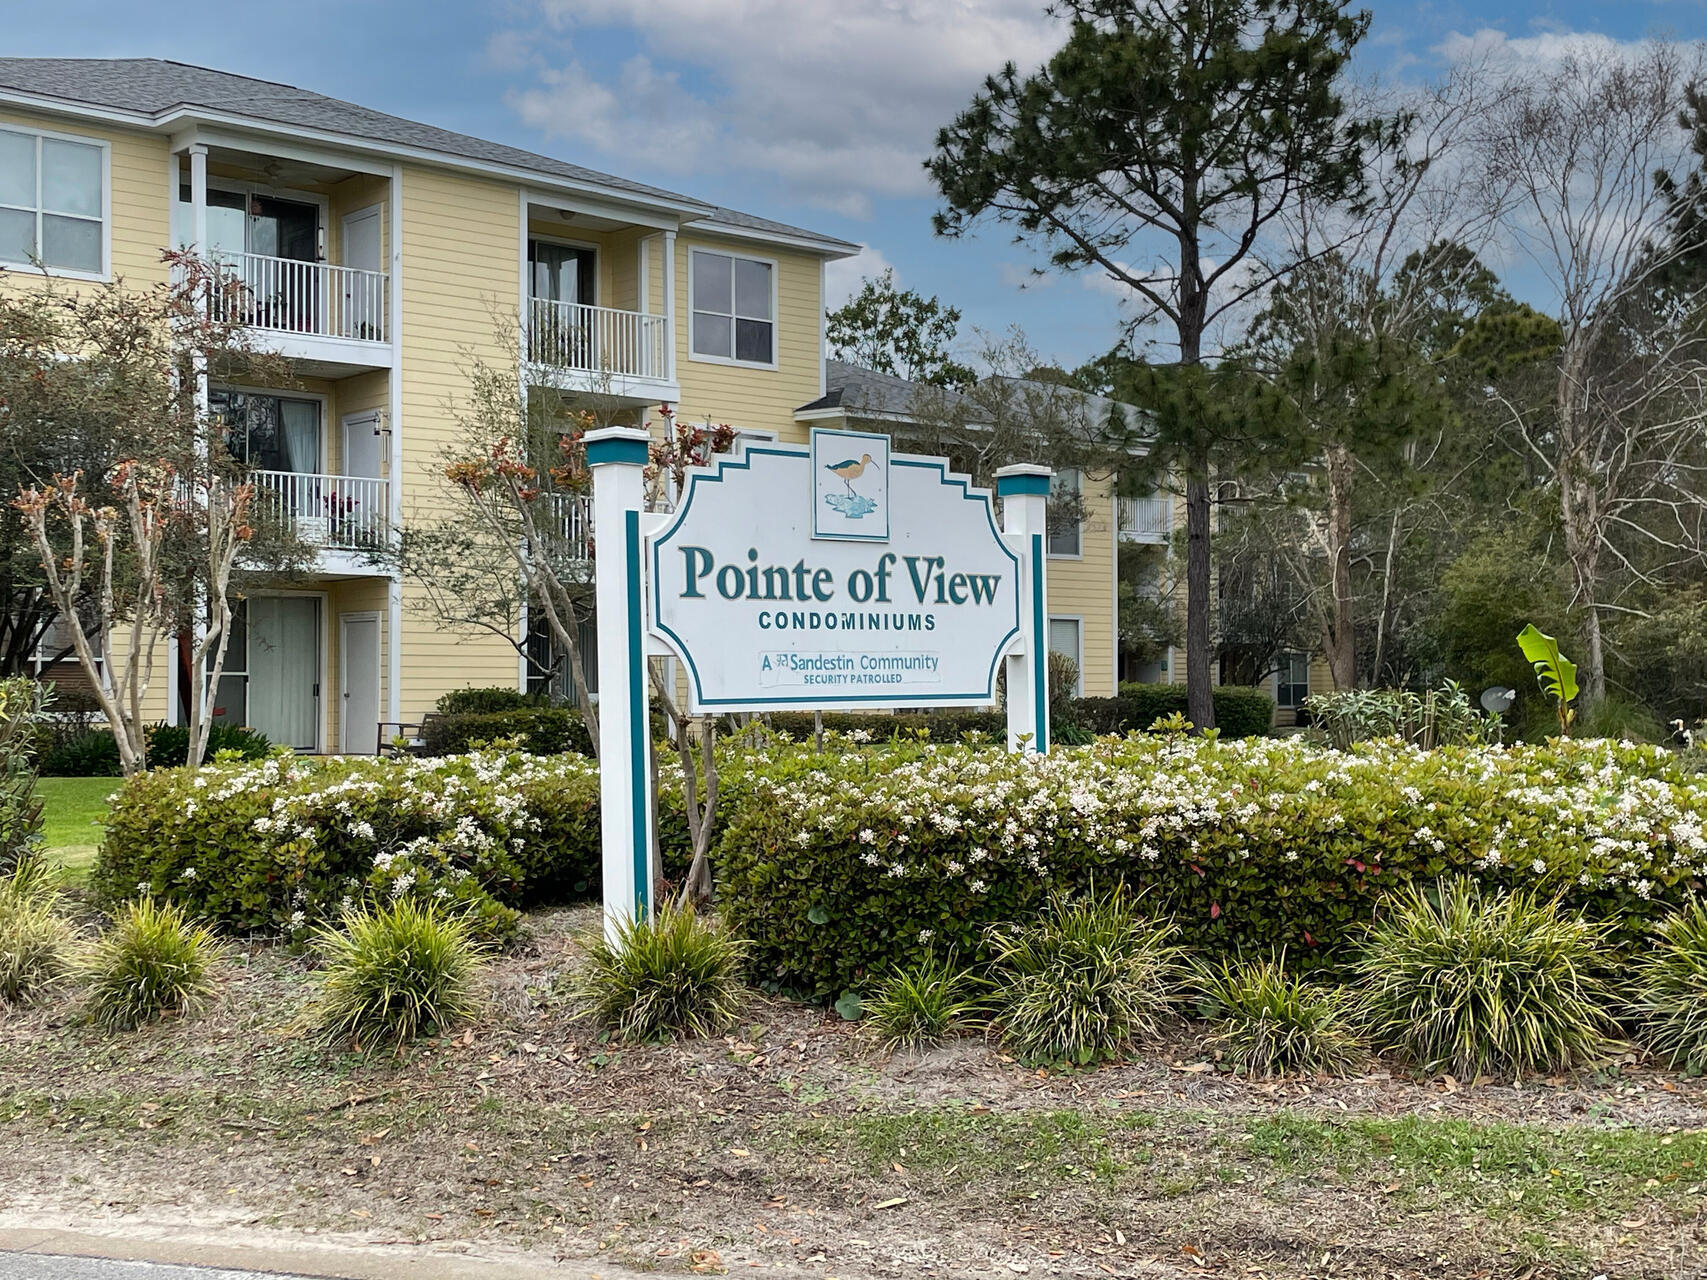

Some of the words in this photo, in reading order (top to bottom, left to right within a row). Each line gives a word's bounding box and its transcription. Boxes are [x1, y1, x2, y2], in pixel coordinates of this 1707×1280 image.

[678, 545, 834, 602] Pointe
[848, 553, 897, 603] of
[903, 556, 1002, 606] View
[758, 611, 936, 631] CONDOMINIUMS
[762, 655, 773, 671] A
[791, 654, 854, 671] Sandestin
[860, 654, 939, 672] Community
[804, 674, 848, 684] SECURITY
[850, 673, 902, 684] PATROLLED
